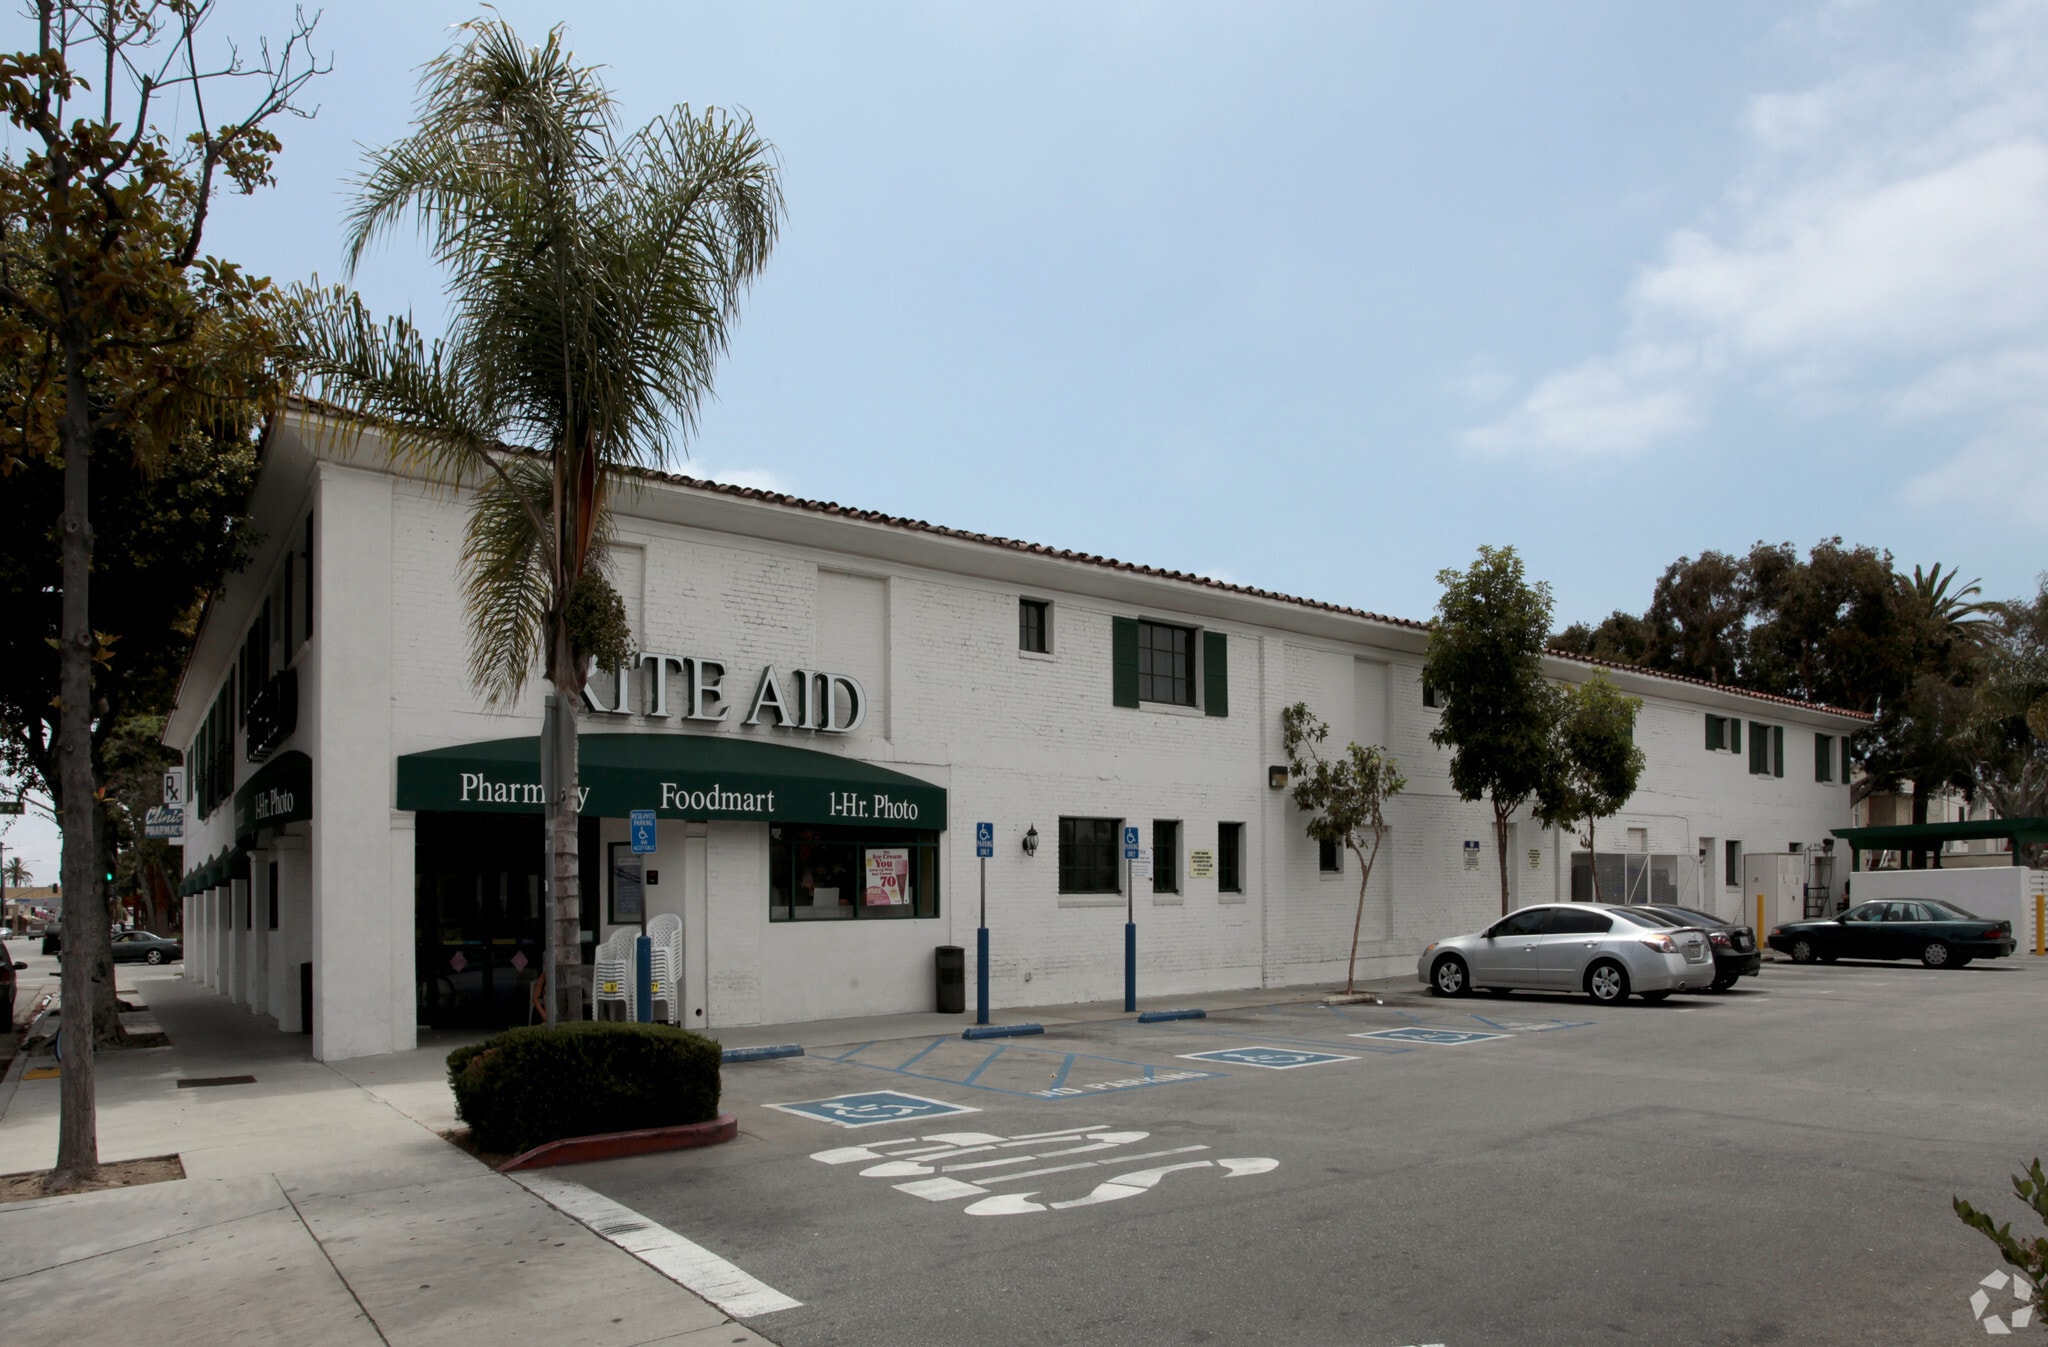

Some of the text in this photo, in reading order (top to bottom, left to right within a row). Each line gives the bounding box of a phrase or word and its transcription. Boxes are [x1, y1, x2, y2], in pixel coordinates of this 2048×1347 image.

[741, 663, 867, 733] AID
[166, 776, 179, 801] Rx
[460, 773, 775, 815] Pharmy Foodmart
[271, 788, 294, 816] Photo
[829, 791, 918, 820] 1-Hr. Photo
[146, 807, 184, 824] Clinic
[875, 859, 893, 868] You
[880, 876, 897, 888] 70
